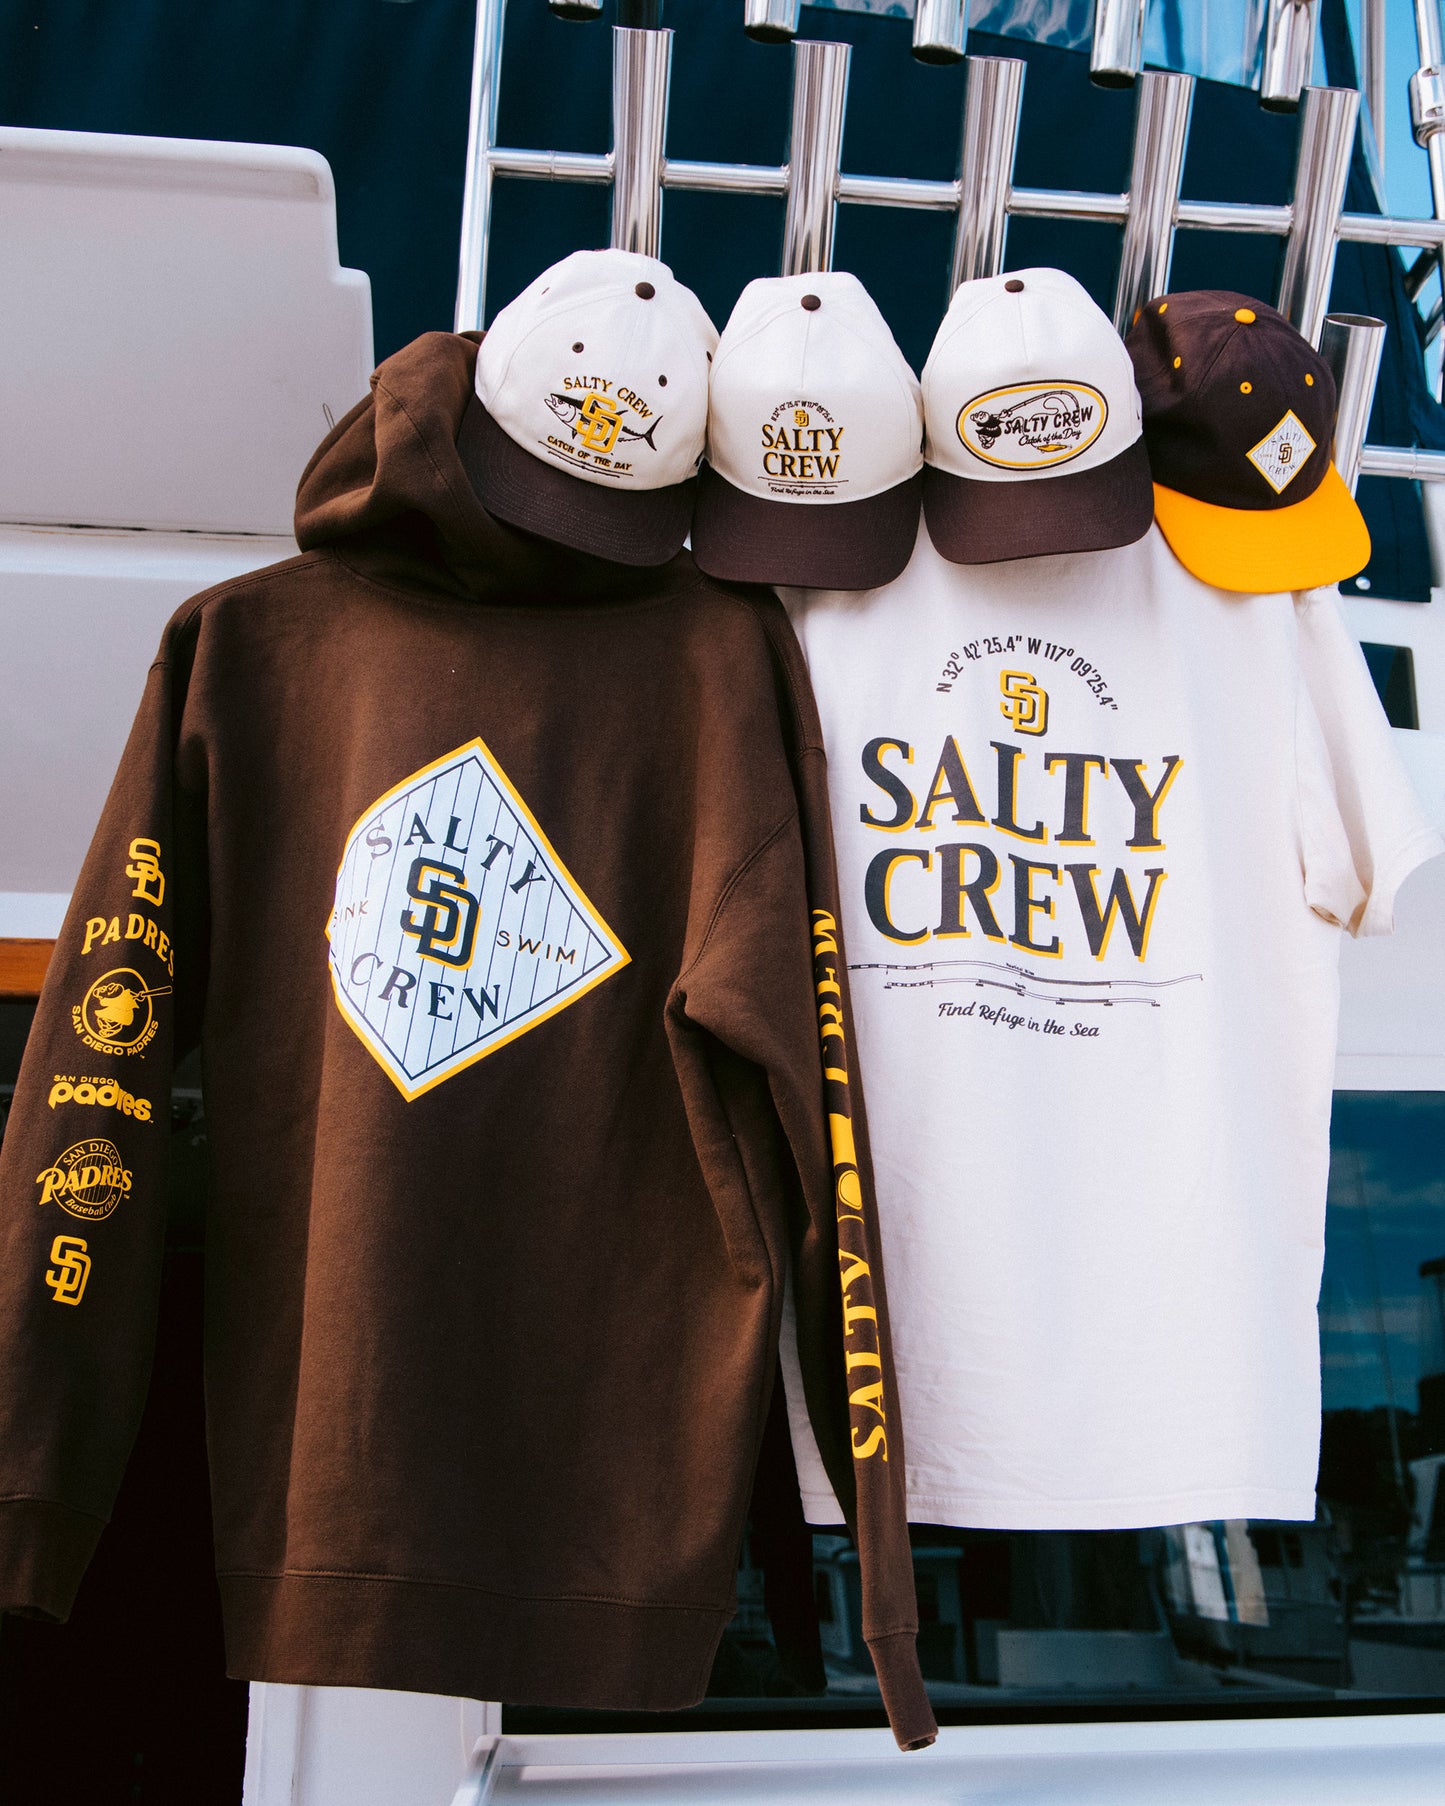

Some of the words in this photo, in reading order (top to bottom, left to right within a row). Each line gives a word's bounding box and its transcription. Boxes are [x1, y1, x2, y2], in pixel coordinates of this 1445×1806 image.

[564, 376, 612, 392] SALTY
[617, 387, 653, 419] CREW
[1004, 416, 1048, 434] SALTY
[1054, 405, 1094, 428] CREW
[762, 424, 844, 452] SALTY
[1042, 434, 1050, 444] of
[1051, 432, 1062, 441] the
[1062, 428, 1082, 440] Day
[547, 435, 575, 454] CATCH
[578, 450, 590, 460] OF
[594, 458, 612, 468] THE
[614, 462, 632, 470] DAY
[763, 452, 840, 480] CREW
[962, 640, 982, 661] 42'
[983, 635, 1022, 654] 25.4"
[1027, 637, 1042, 655] W
[1044, 642, 1075, 662] 117°
[942, 652, 964, 680] 32°
[936, 682, 952, 693] N
[860, 734, 1184, 852] SALTY
[366, 812, 546, 894] SALTY
[864, 842, 1168, 963] CREW
[496, 930, 576, 965] SWIM
[350, 951, 500, 1022] CREW
[72, 1005, 85, 1035] SAN
[82, 1033, 124, 1056] DIEGO
[126, 1020, 159, 1057] PADRES
[938, 1001, 976, 1018] Find
[978, 1004, 1025, 1030] Refuge
[1028, 1016, 1040, 1032] in
[1042, 1018, 1066, 1035] the
[1070, 1022, 1100, 1037] Sea
[53, 1074, 76, 1083] SAN
[80, 1075, 114, 1085] DIEGO
[48, 1079, 152, 1122] padres
[62, 1146, 86, 1166] SAN
[89, 1142, 119, 1166] DIEGO
[36, 1164, 133, 1206] PADRES
[64, 1198, 104, 1216] Baseball
[104, 1193, 118, 1213] Club
[838, 1248, 888, 1462] SALTY
